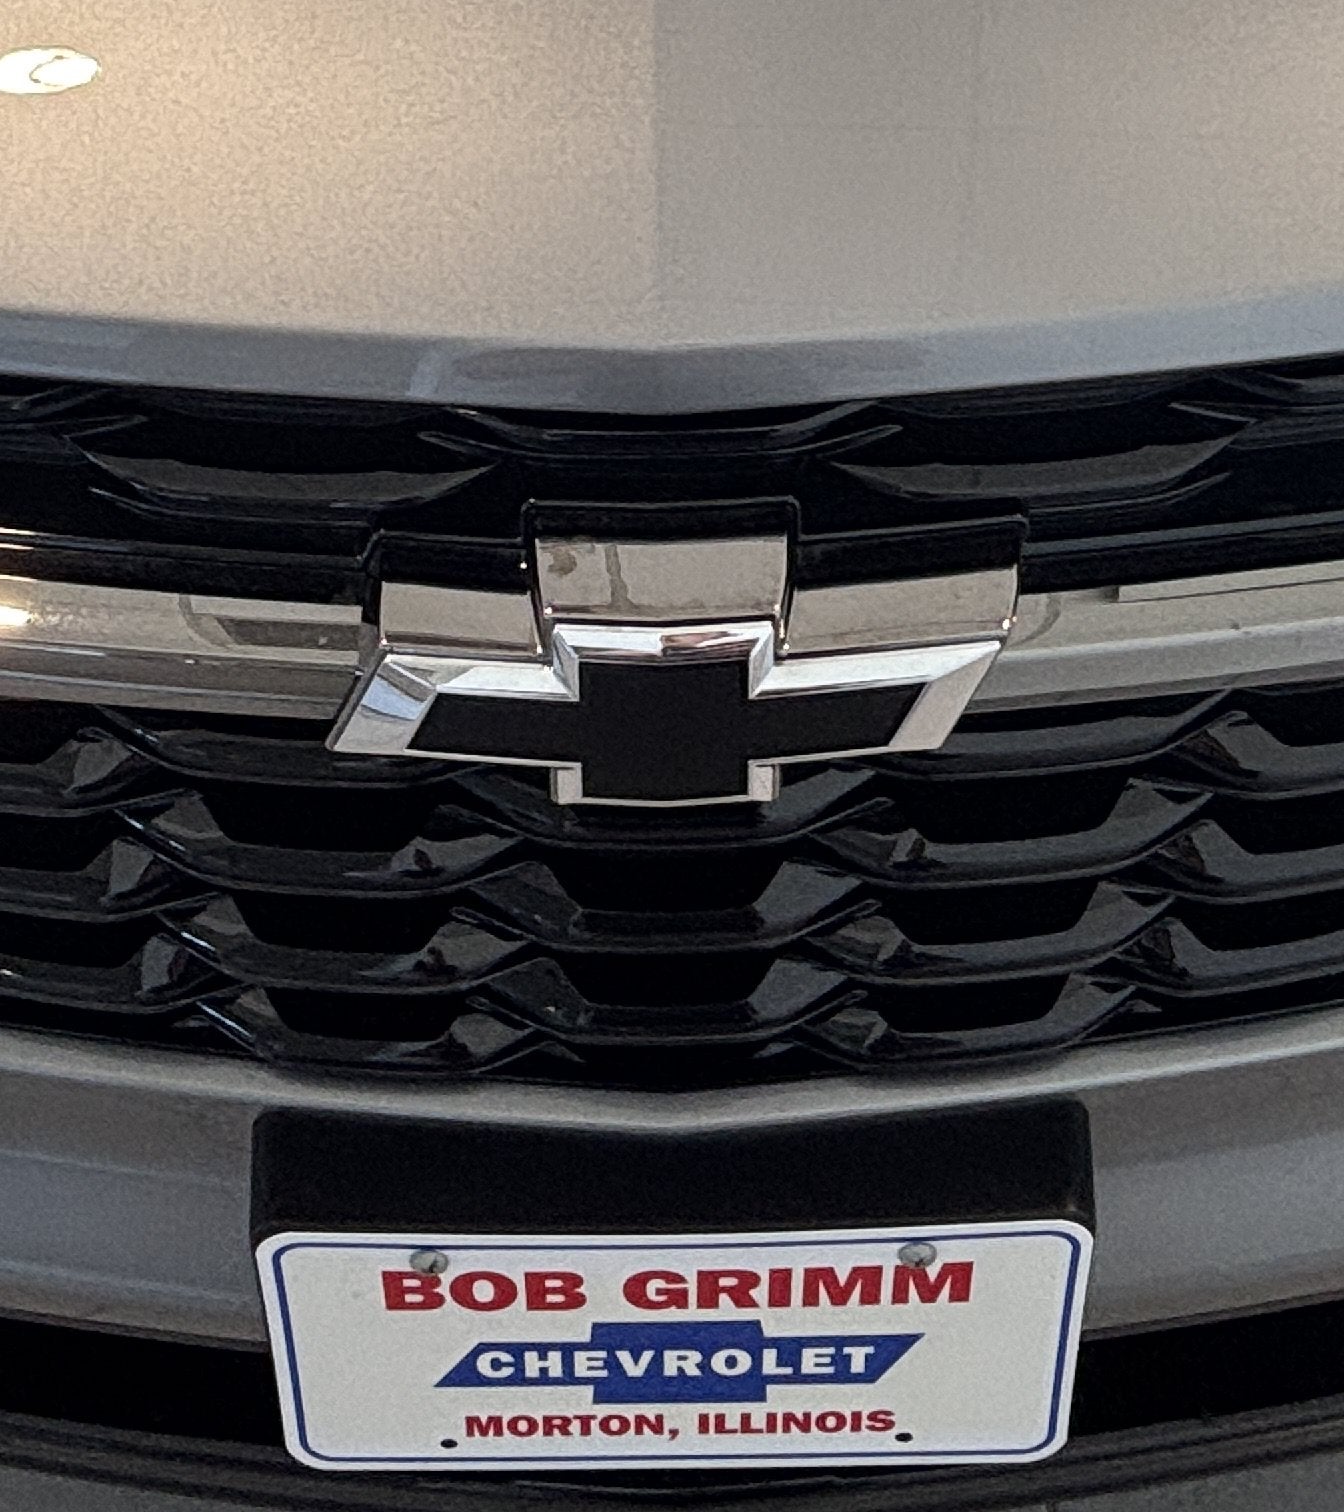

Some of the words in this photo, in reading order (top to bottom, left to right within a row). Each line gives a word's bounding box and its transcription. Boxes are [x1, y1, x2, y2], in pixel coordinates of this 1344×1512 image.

[381, 1270, 588, 1312] BOB
[622, 1260, 974, 1310] GRIMM
[475, 1345, 875, 1380] CHEVROLET
[464, 1414, 680, 1441] MORTON,
[697, 1410, 897, 1436] ILLINOIS
